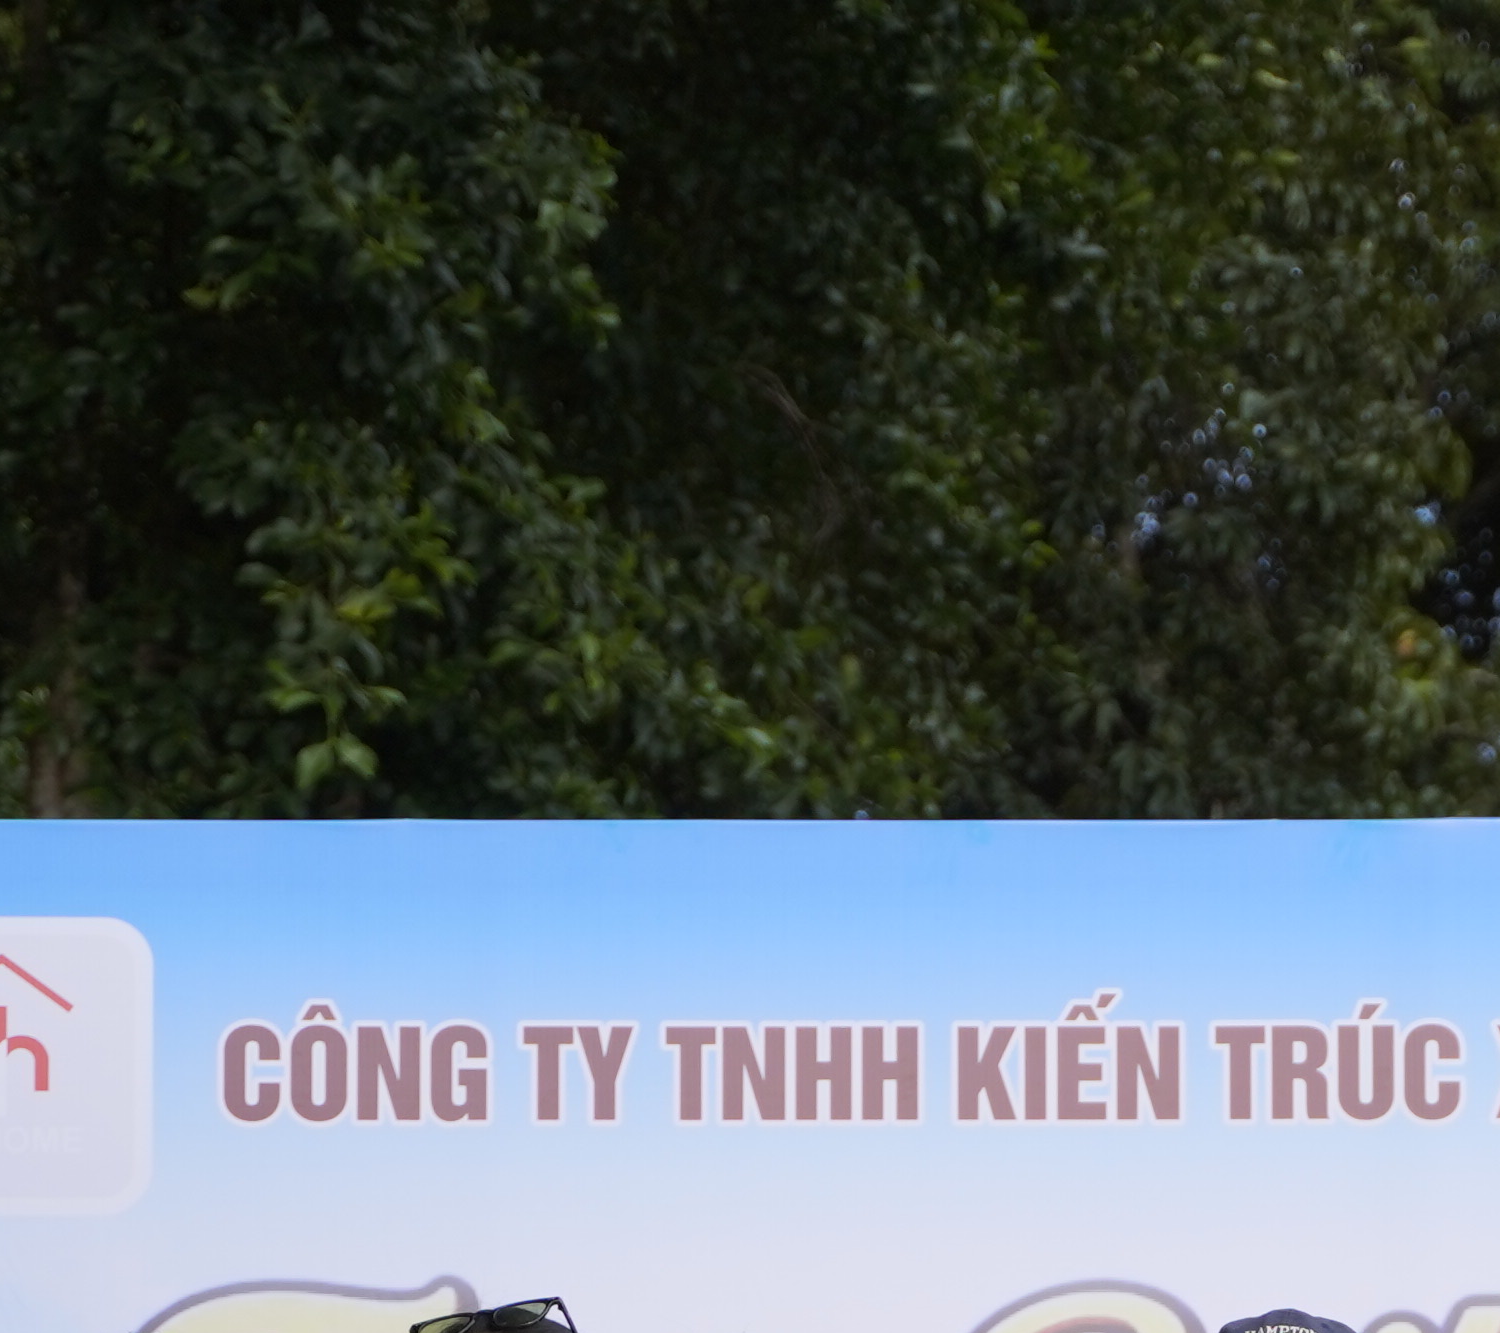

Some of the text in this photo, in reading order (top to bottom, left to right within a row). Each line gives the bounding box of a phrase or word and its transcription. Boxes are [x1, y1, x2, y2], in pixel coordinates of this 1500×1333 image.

[224, 1005, 487, 1122] CÔNG
[524, 1027, 632, 1120] TY
[666, 1027, 918, 1120] TNHH
[958, 995, 1179, 1120] KIẾN
[1216, 1005, 1460, 1120] TRÚC
